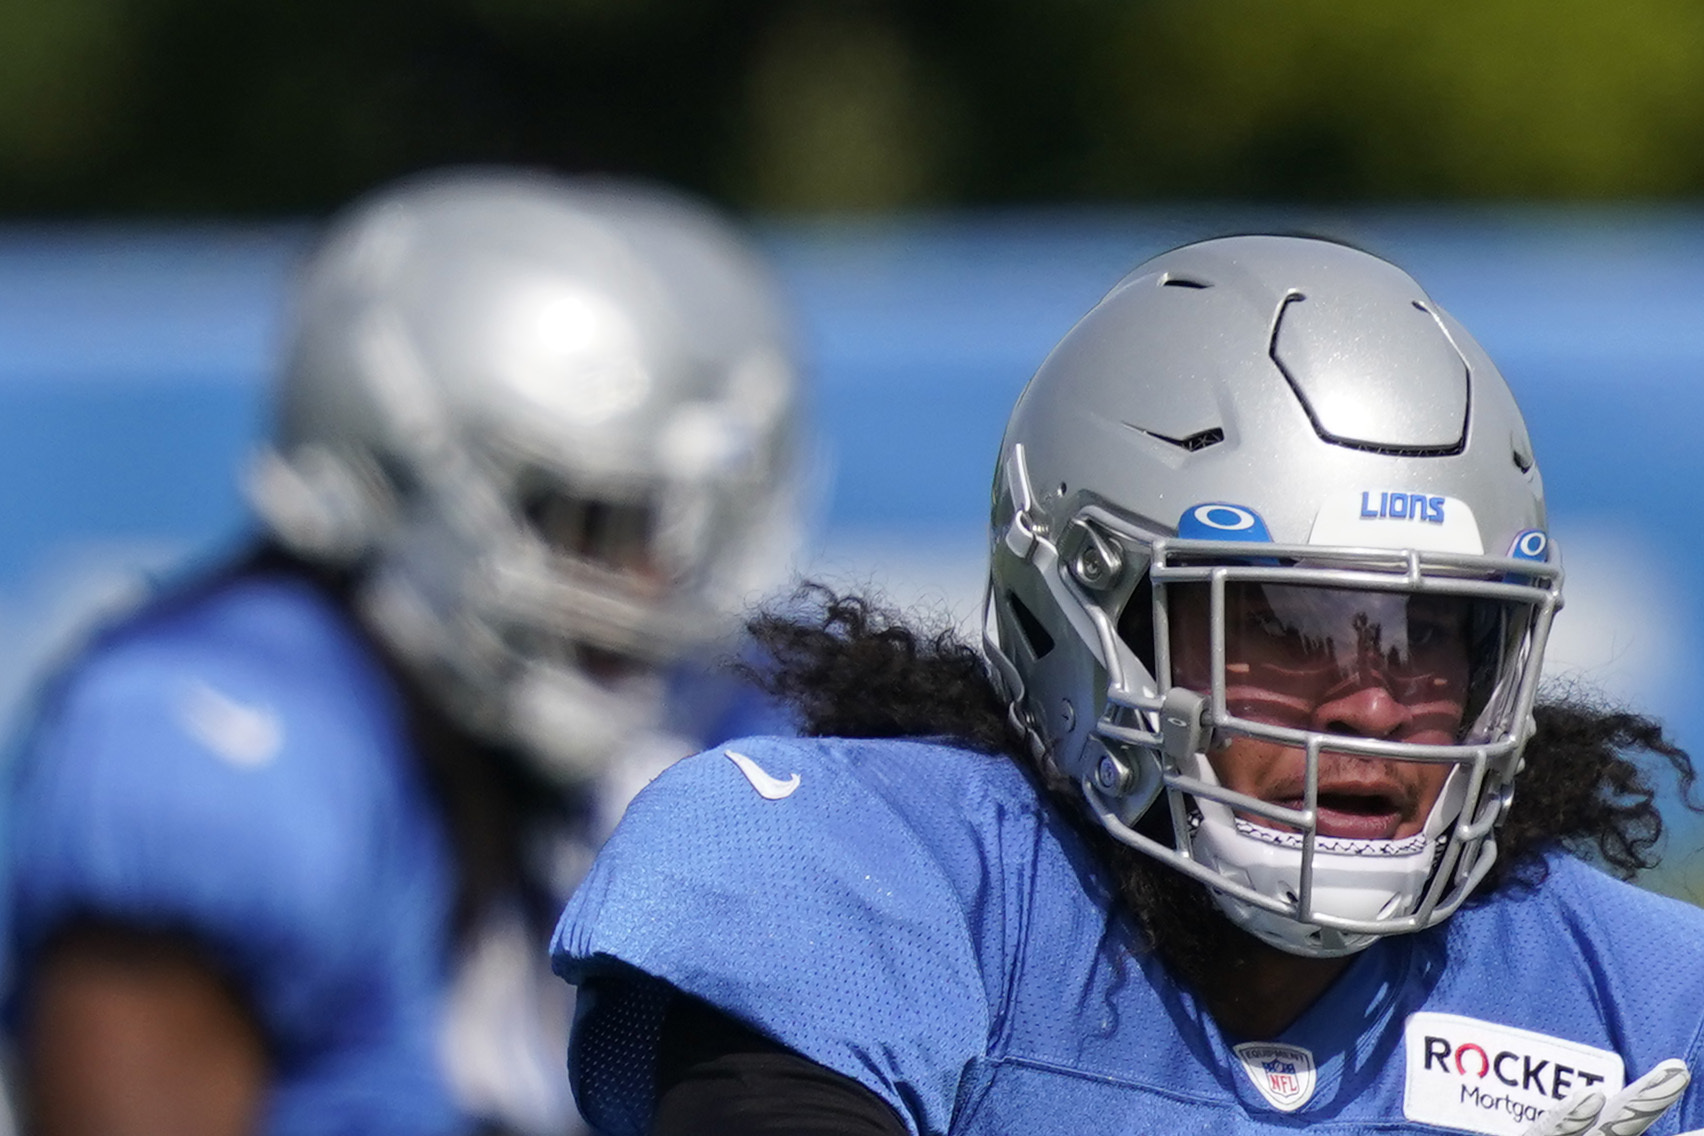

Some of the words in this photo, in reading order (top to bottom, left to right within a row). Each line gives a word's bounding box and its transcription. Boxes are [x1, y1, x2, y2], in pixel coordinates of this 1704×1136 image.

[1360, 491, 1446, 524] LIONS
[1269, 1074, 1297, 1093] NFL
[1423, 1035, 1605, 1101] ROCKET
[1460, 1083, 1546, 1123] Mortga
